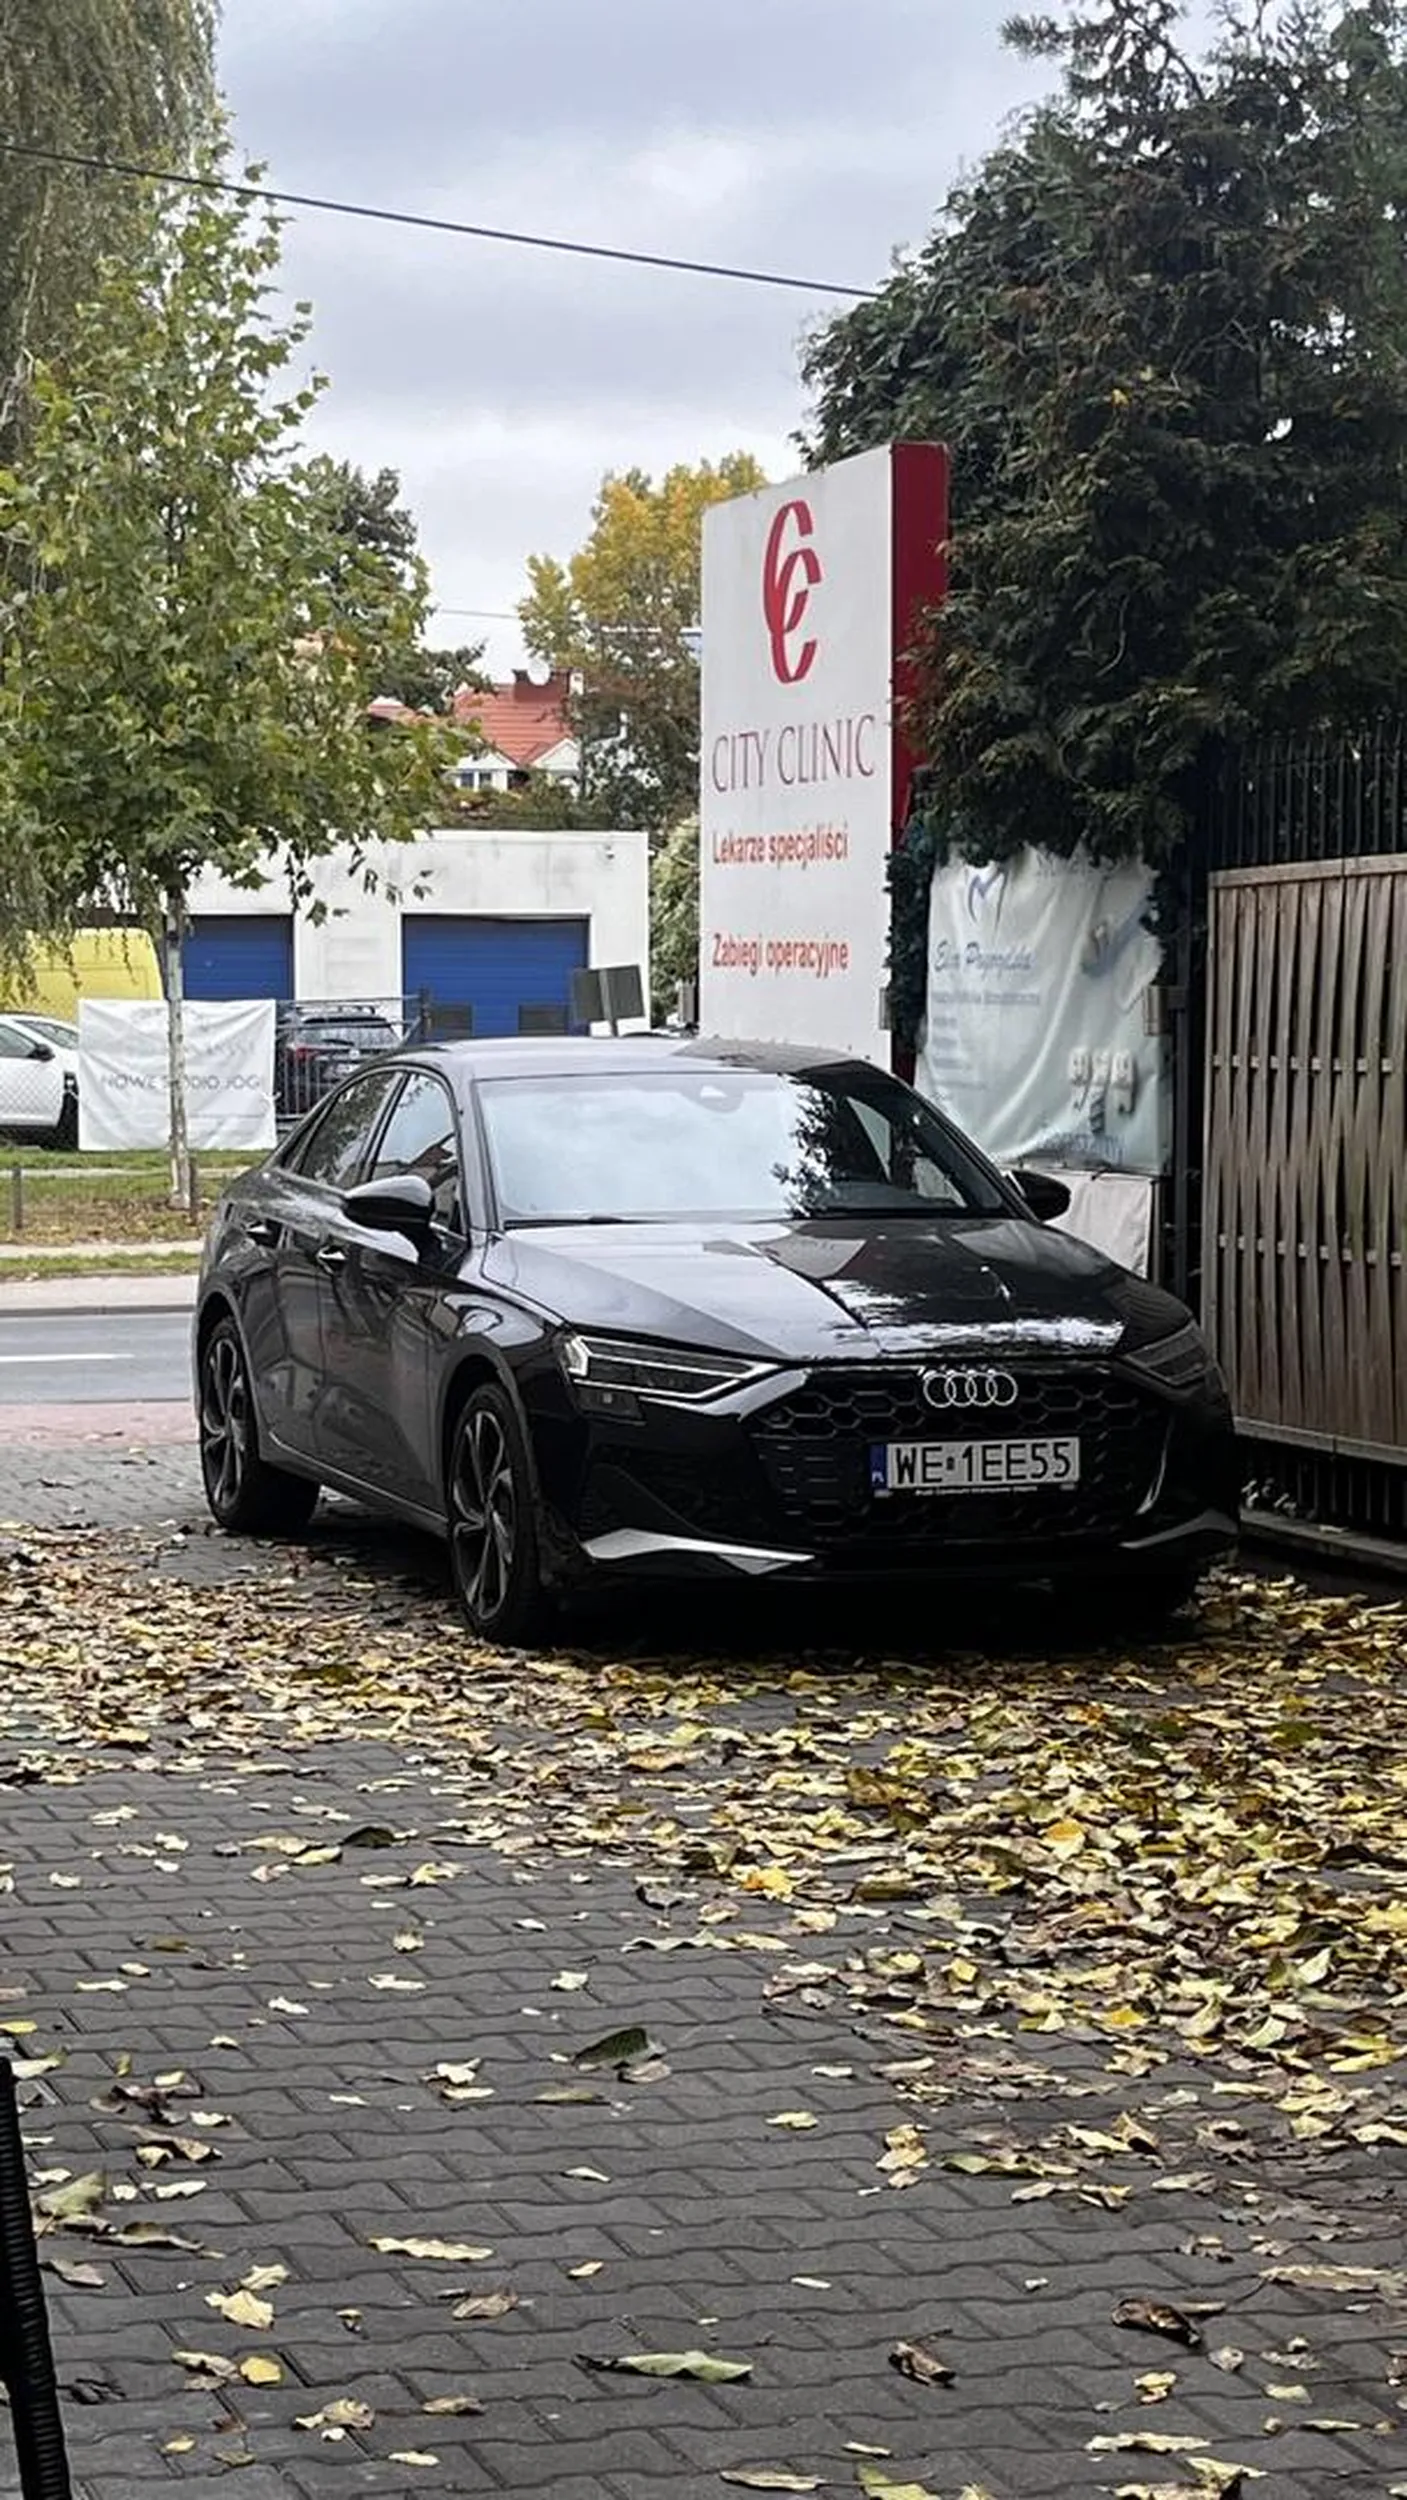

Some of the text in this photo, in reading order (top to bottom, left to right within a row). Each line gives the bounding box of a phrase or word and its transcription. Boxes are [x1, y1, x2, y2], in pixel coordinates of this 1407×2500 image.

[712, 714, 875, 793] CITY CLINIC
[713, 820, 849, 870] Lekarze specjaliści
[713, 932, 849, 978] Zabiegi operacyjne
[896, 1446, 943, 1484] WE
[962, 1442, 1071, 1482] 1EE55
